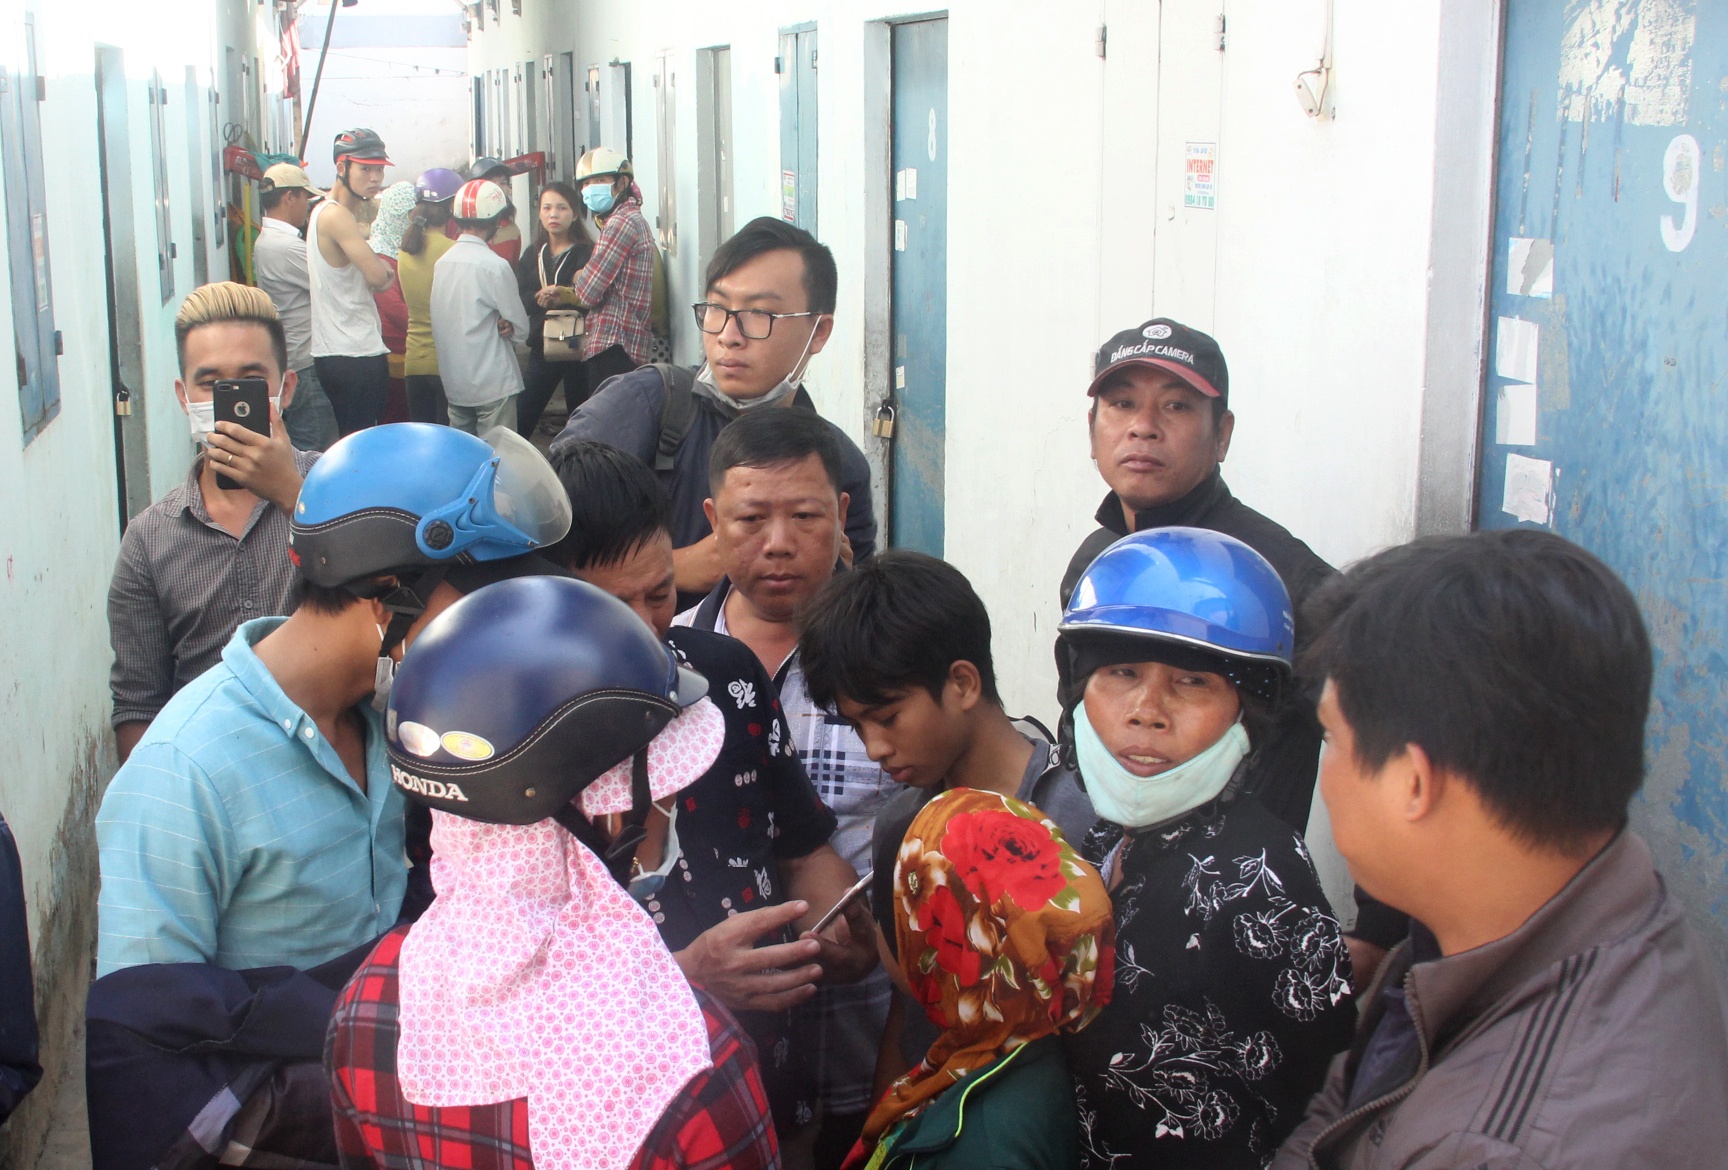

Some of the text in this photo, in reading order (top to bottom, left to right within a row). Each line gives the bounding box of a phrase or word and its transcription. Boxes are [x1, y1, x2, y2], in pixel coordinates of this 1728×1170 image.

[928, 107, 936, 161] 8
[1187, 159, 1214, 174] INTERNET
[1660, 134, 1700, 253] 9
[1155, 345, 1194, 364] CAMERA
[391, 764, 469, 802] HONDA
